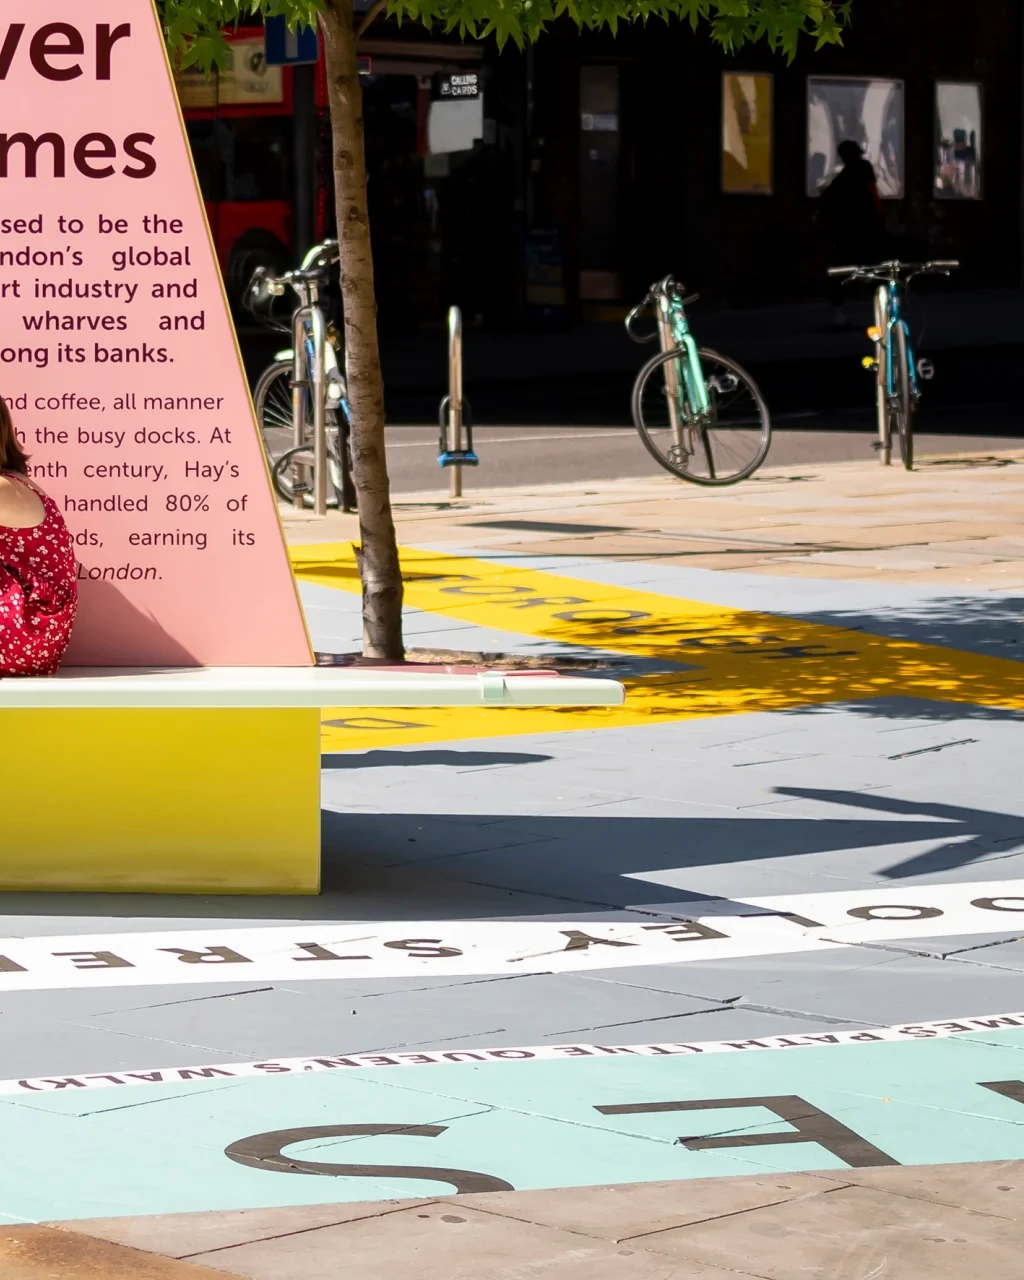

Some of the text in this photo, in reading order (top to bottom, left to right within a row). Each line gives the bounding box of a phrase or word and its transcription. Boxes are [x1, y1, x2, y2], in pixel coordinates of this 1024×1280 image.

[57, 215, 84, 234] to
[98, 213, 129, 234] be
[142, 213, 183, 234] the
[111, 245, 191, 272] global
[34, 278, 139, 304] industry
[151, 278, 197, 299] and
[22, 310, 128, 331] wharves
[158, 310, 205, 331] and
[57, 342, 86, 363] its
[94, 342, 174, 363] banks.
[5, 393, 27, 410] nd
[34, 392, 106, 412] coffee,
[113, 392, 137, 410] all
[143, 397, 224, 410] manner
[34, 426, 69, 444] the
[77, 426, 126, 449] busy
[134, 426, 201, 444] docks.
[209, 426, 232, 444] At
[83, 462, 168, 483] century,
[185, 460, 240, 483] Hay's
[64, 494, 148, 512] handled
[165, 494, 210, 512] 80%
[226, 494, 248, 512] of
[128, 528, 207, 551] earning
[232, 528, 255, 546] its
[76, 563, 163, 580] London.
[898, 1016, 1024, 1038] MES
[725, 1031, 886, 1050] PATH
[17, 1066, 238, 1091] WALK)
